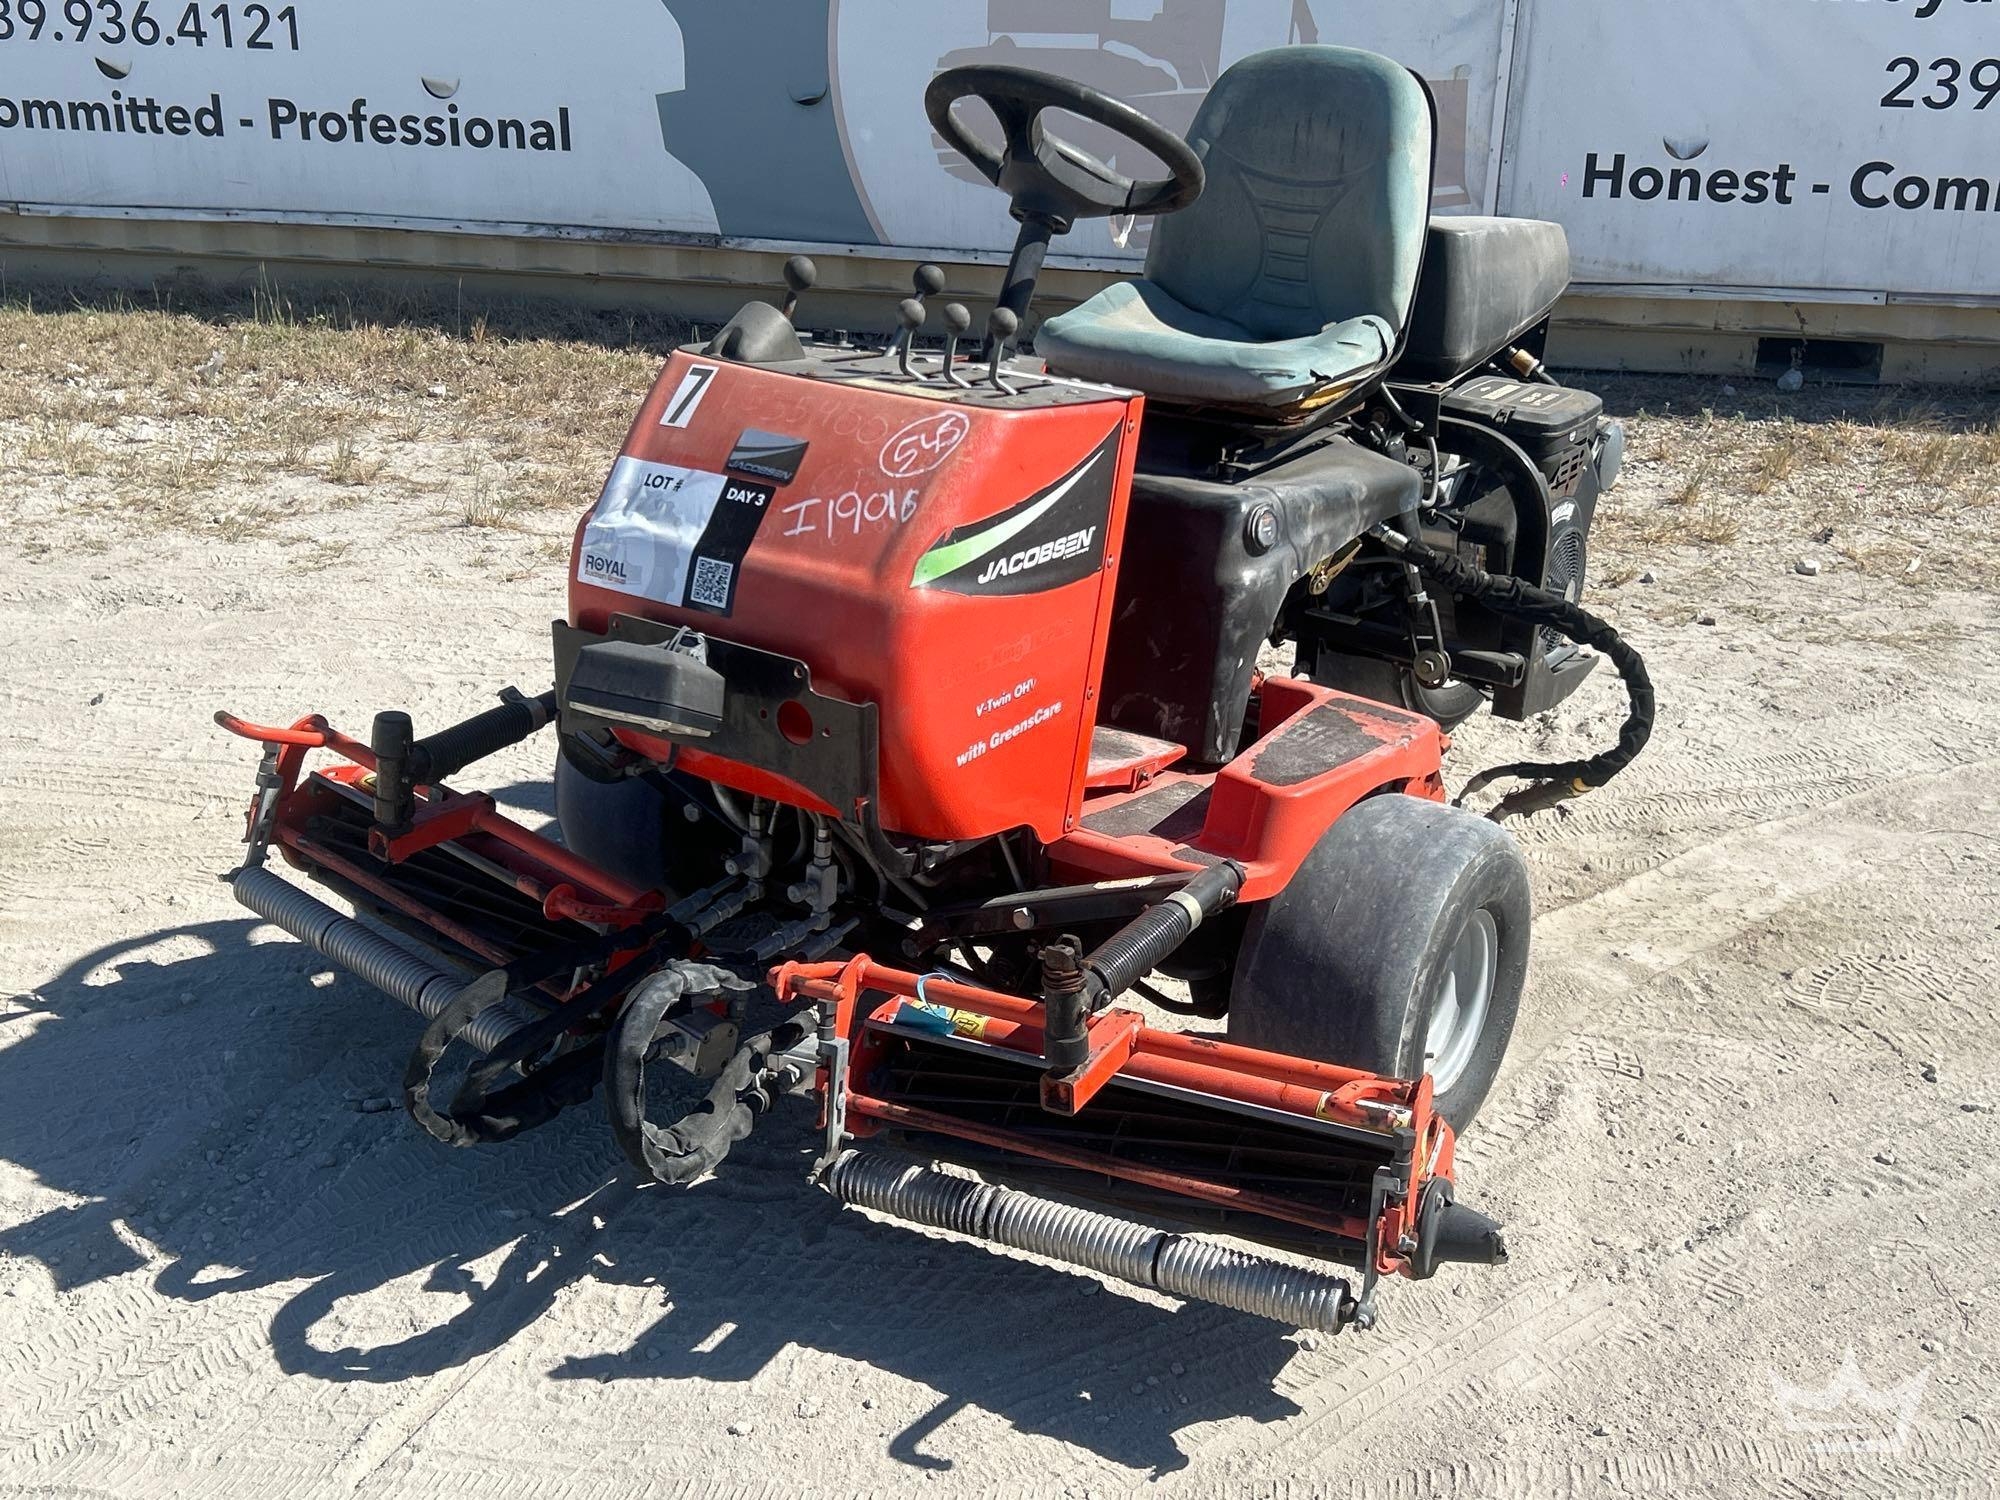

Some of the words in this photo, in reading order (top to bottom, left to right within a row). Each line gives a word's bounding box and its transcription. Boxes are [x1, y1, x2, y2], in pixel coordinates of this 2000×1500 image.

[269, 99, 570, 151] Professional
[1582, 153, 1795, 205] Honest
[1850, 161, 2000, 212] Com
[668, 366, 714, 423] 7
[644, 473, 673, 491] LOT
[673, 479, 684, 491] #
[728, 461, 792, 480] JACOBSEN
[726, 487, 756, 503] DAY
[754, 494, 765, 506] 3
[586, 554, 627, 578] ROYAL
[978, 525, 1096, 585] JACOBSEN
[976, 692, 1011, 717] V-Twin
[956, 741, 986, 767] with
[990, 701, 1062, 748] GreensCare
